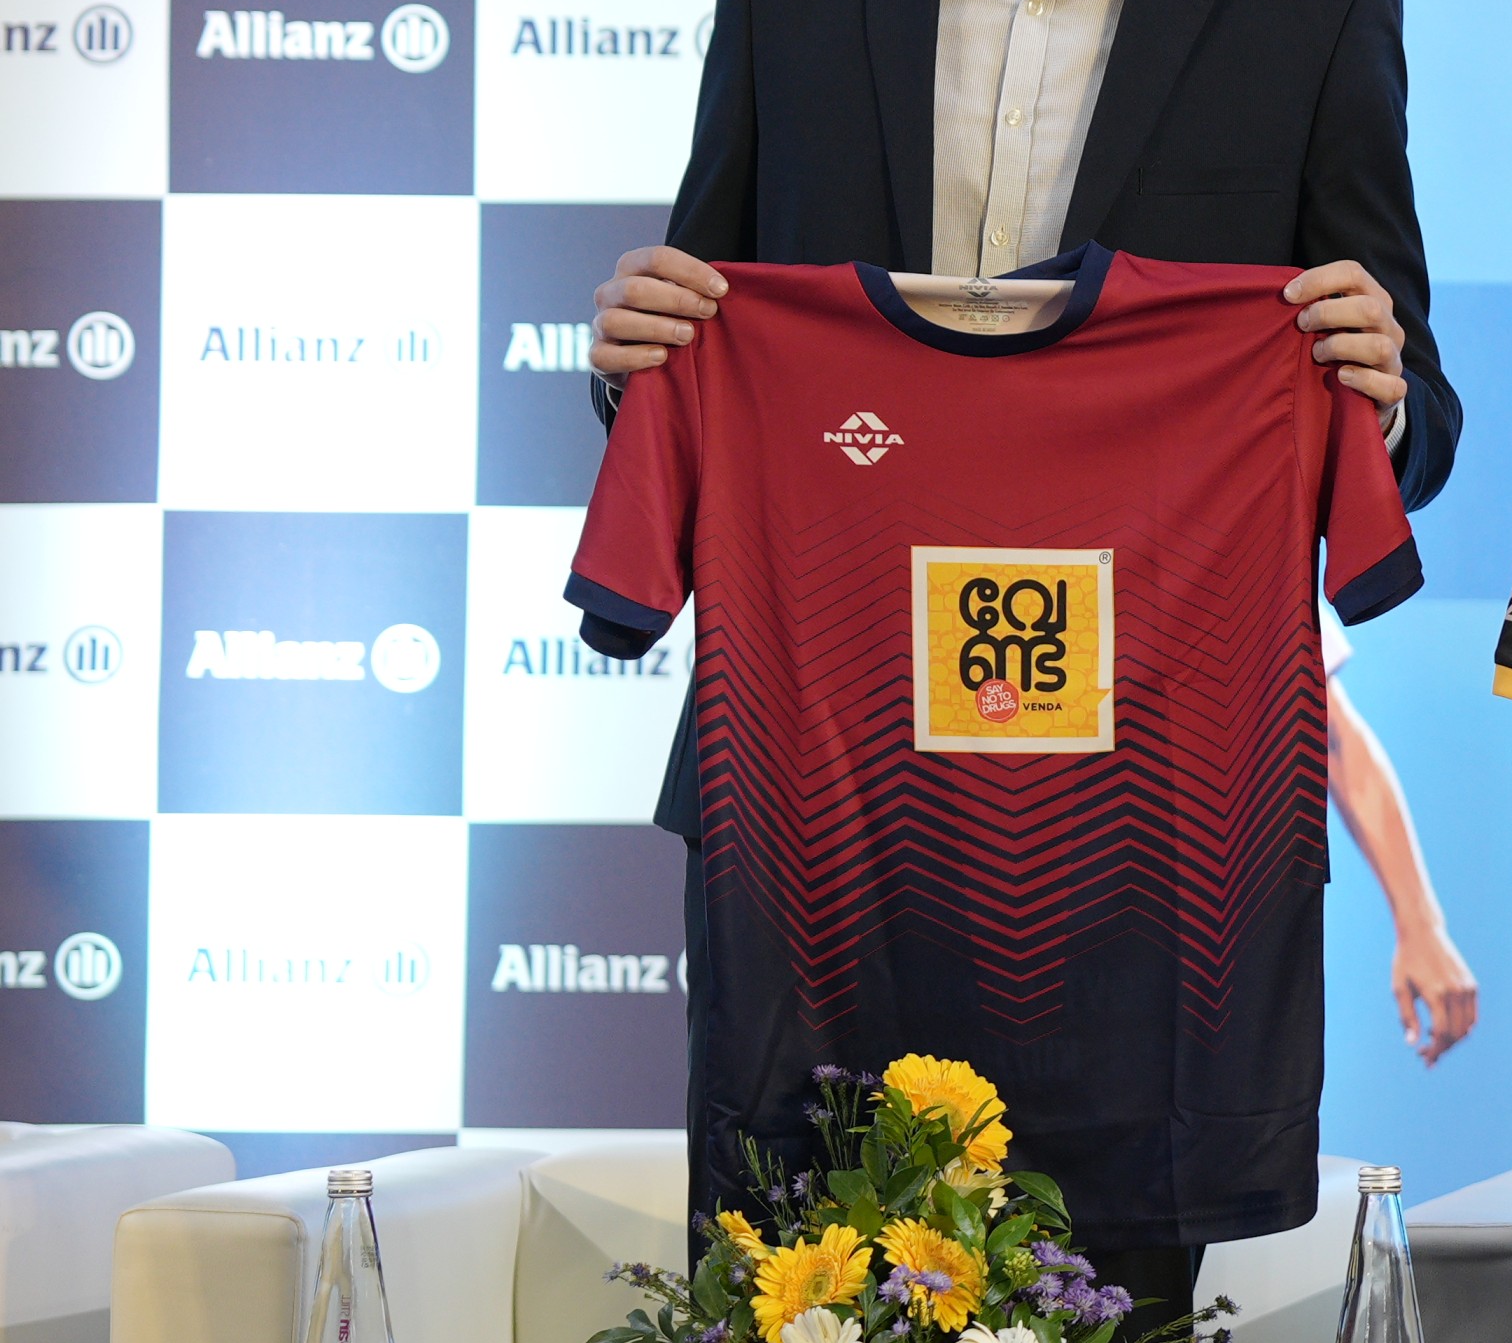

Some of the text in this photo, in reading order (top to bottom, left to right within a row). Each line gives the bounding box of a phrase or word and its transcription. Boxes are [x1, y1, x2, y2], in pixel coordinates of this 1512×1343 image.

[197, 10, 374, 61] Allianz
[511, 16, 680, 58] Allianz
[199, 325, 366, 364] Allianz
[503, 322, 592, 372] Alli
[824, 430, 905, 447] NIVIA
[187, 630, 365, 683] Allianz
[982, 692, 1011, 703] NO TO
[982, 700, 1016, 714] DRUGS
[986, 684, 1004, 694] SAY
[1022, 702, 1063, 711] VENDA
[187, 948, 354, 985] Allianz
[491, 943, 669, 994] Allianz
